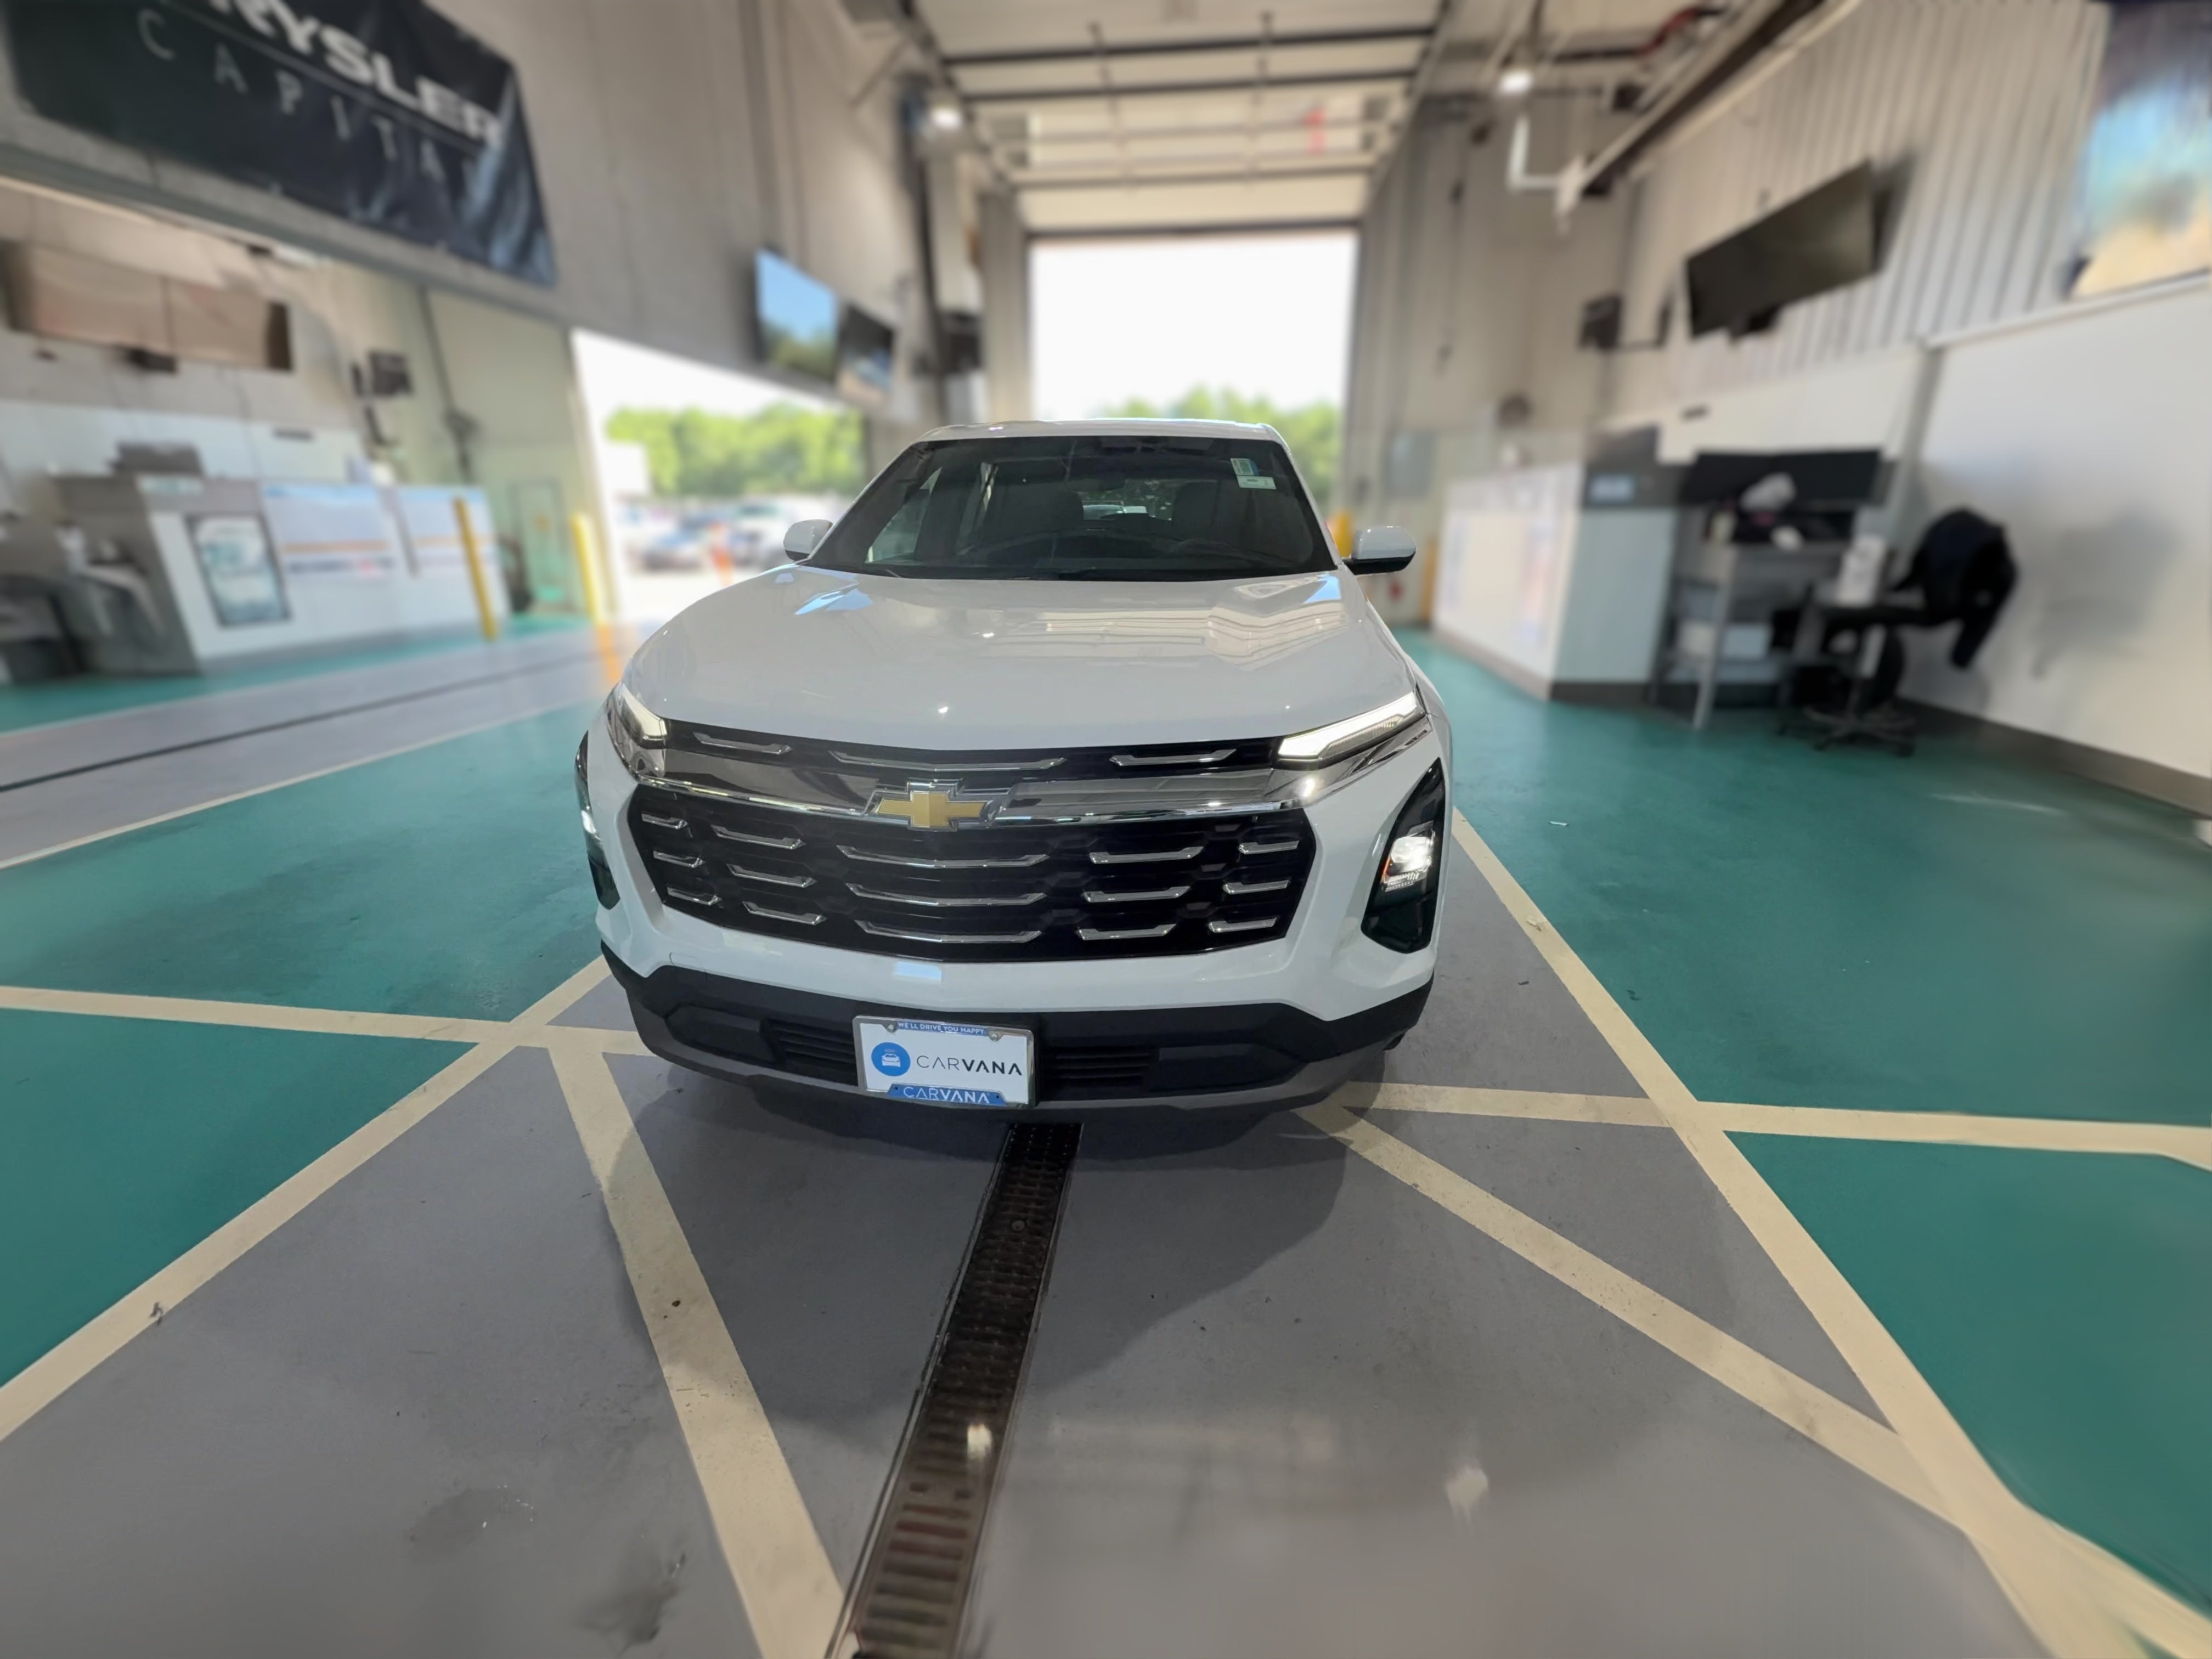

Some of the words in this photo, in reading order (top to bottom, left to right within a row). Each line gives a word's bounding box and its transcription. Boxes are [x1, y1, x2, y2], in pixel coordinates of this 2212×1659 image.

[210, 0, 501, 147] RYSLER
[917, 1055, 1022, 1075] CARVANA
[904, 1087, 989, 1103] CARVANA
